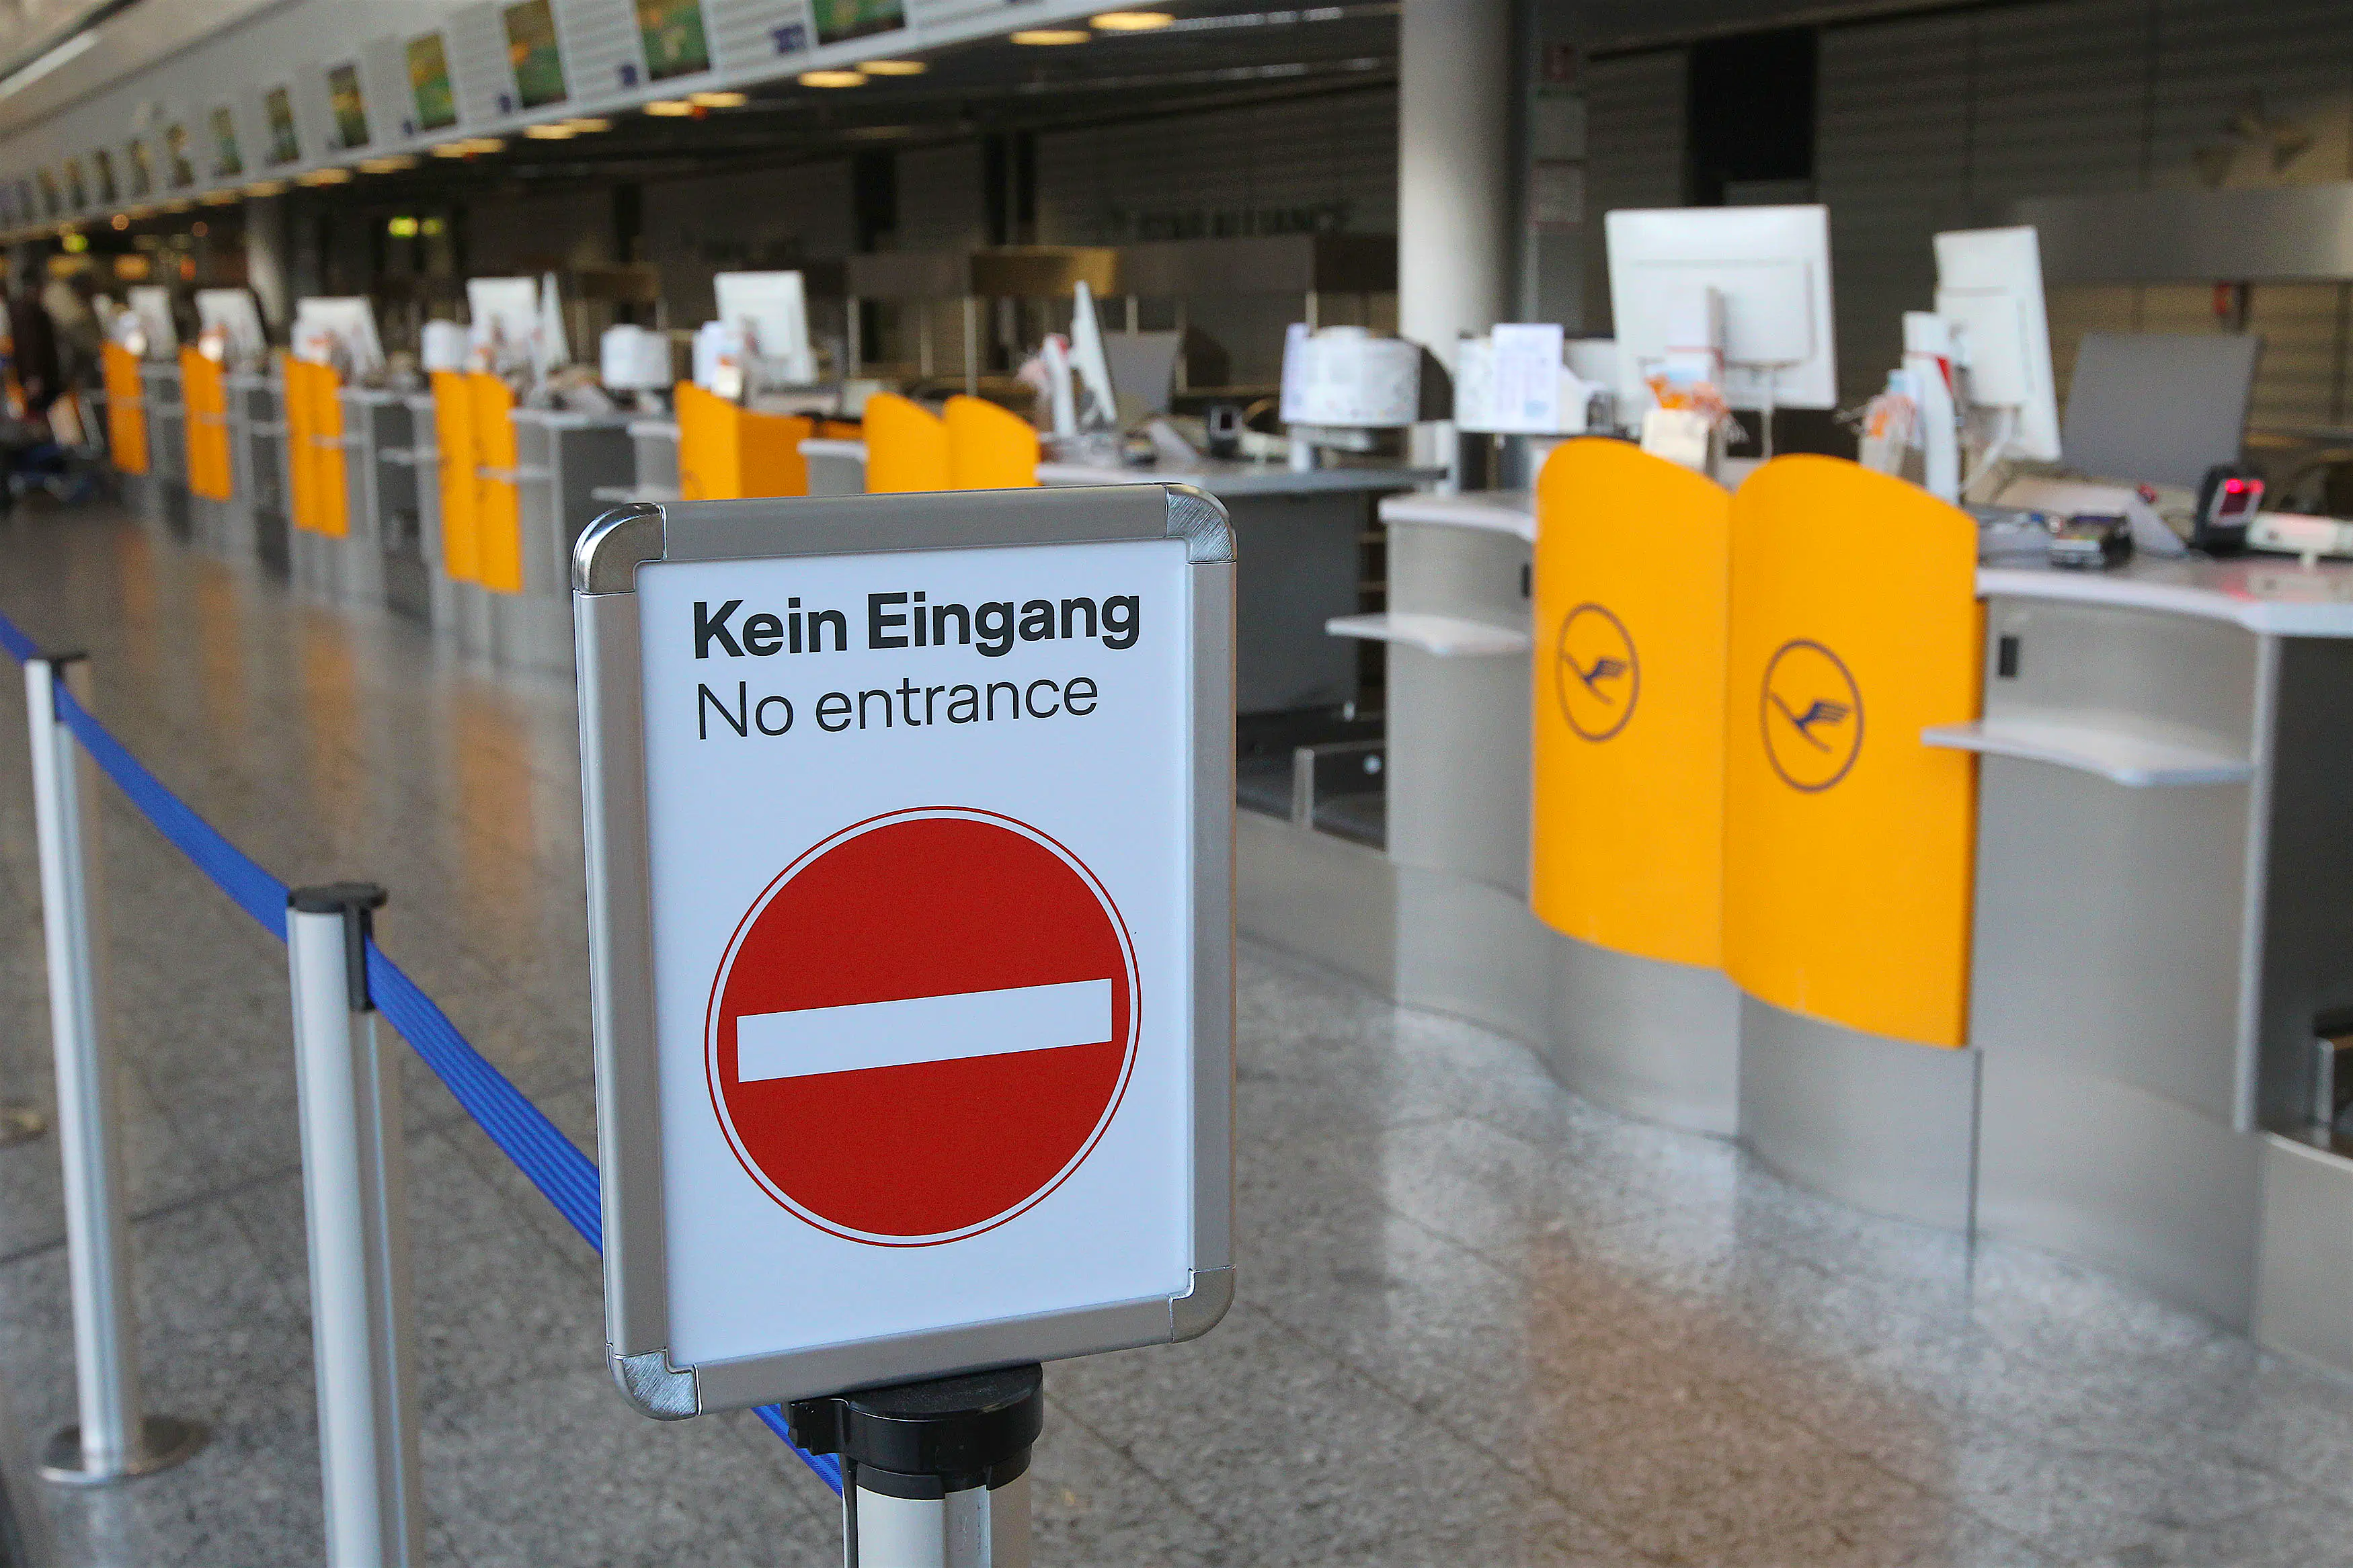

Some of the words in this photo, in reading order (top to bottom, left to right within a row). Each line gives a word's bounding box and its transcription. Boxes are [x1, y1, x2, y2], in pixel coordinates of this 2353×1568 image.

[693, 597, 848, 659] Kein
[867, 591, 1140, 657] Eingang
[698, 681, 794, 740] No
[815, 677, 1098, 733] entrance
